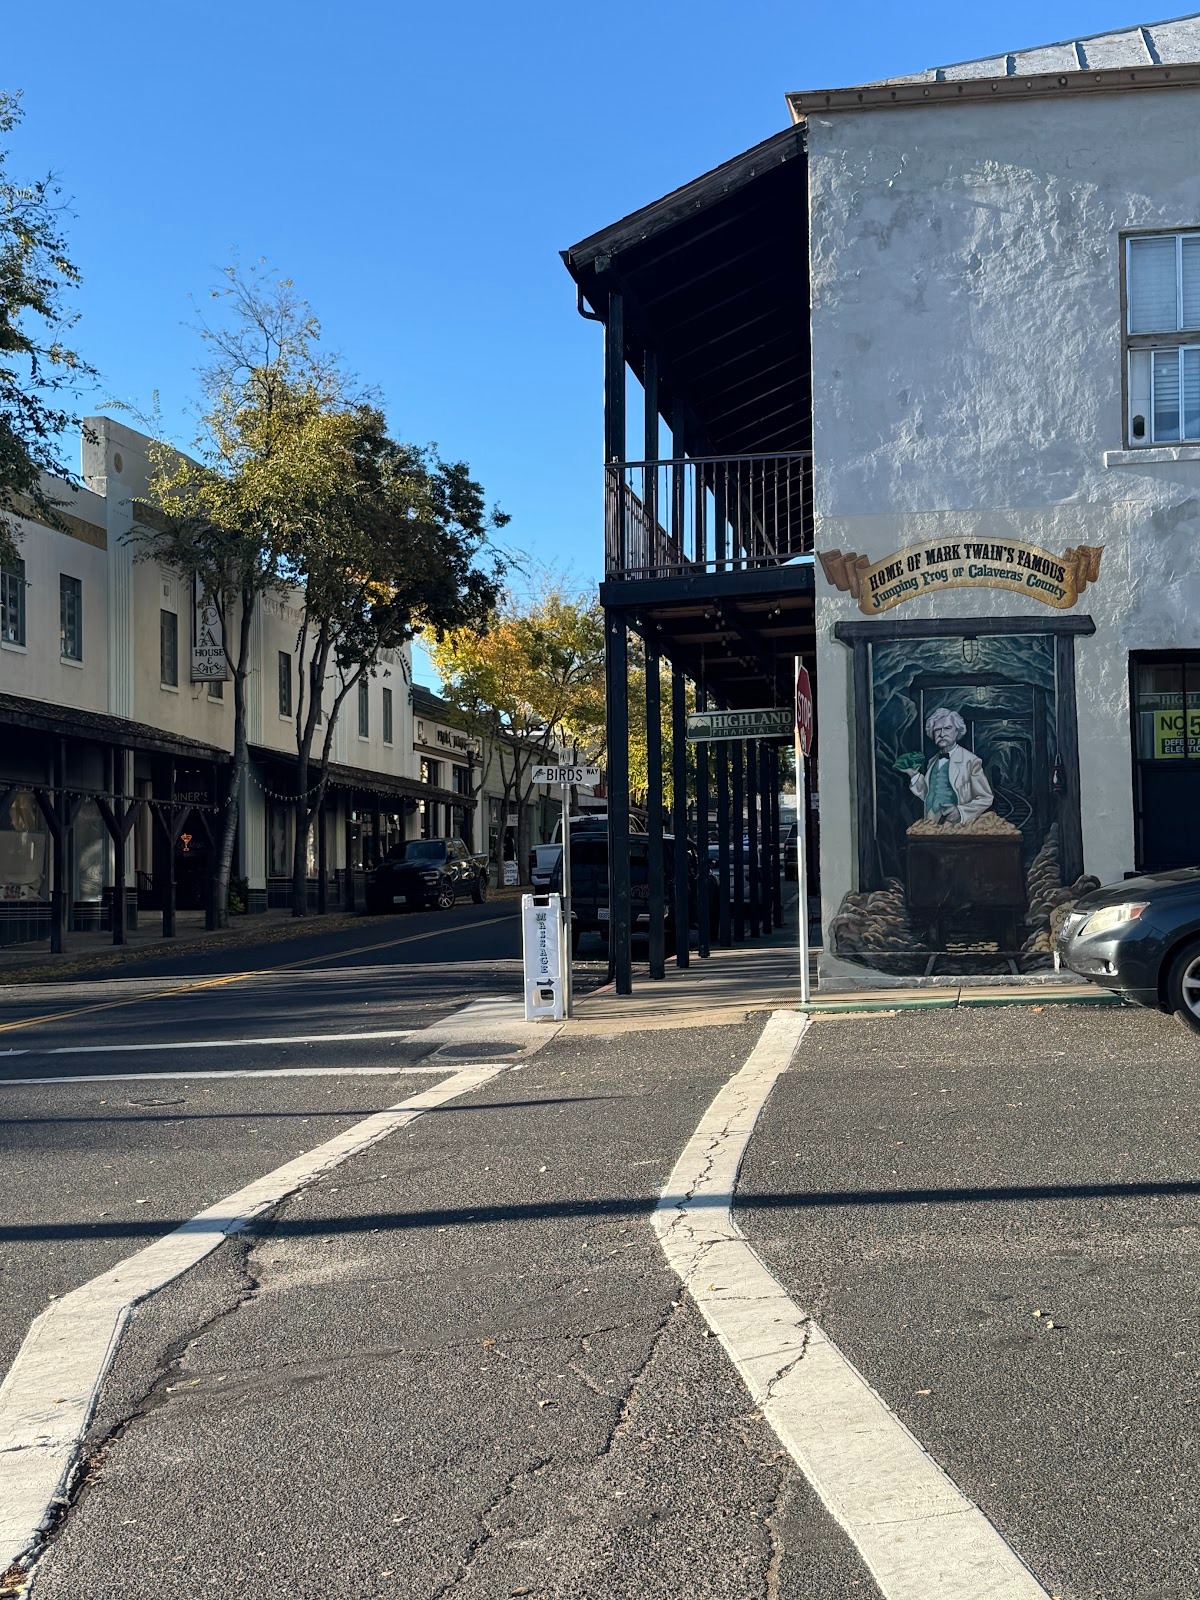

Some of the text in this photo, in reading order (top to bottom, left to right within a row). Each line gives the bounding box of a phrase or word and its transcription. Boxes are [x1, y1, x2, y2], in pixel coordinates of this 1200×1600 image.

[869, 543, 1066, 591] HOME OF MARK TWAIN'S FAMOUS
[871, 577, 919, 608] Jumping
[921, 568, 948, 587] Frog
[968, 564, 1023, 582] Calaveras
[1026, 573, 1067, 600] County
[194, 649, 225, 657] HOUSE
[798, 690, 812, 729] STOP
[712, 712, 791, 728] HIGHLAND
[1161, 716, 1185, 731] NO
[712, 724, 790, 736] FINANCIAL CO
[546, 768, 583, 781] BIRDS
[535, 912, 549, 974] MASSAGE
